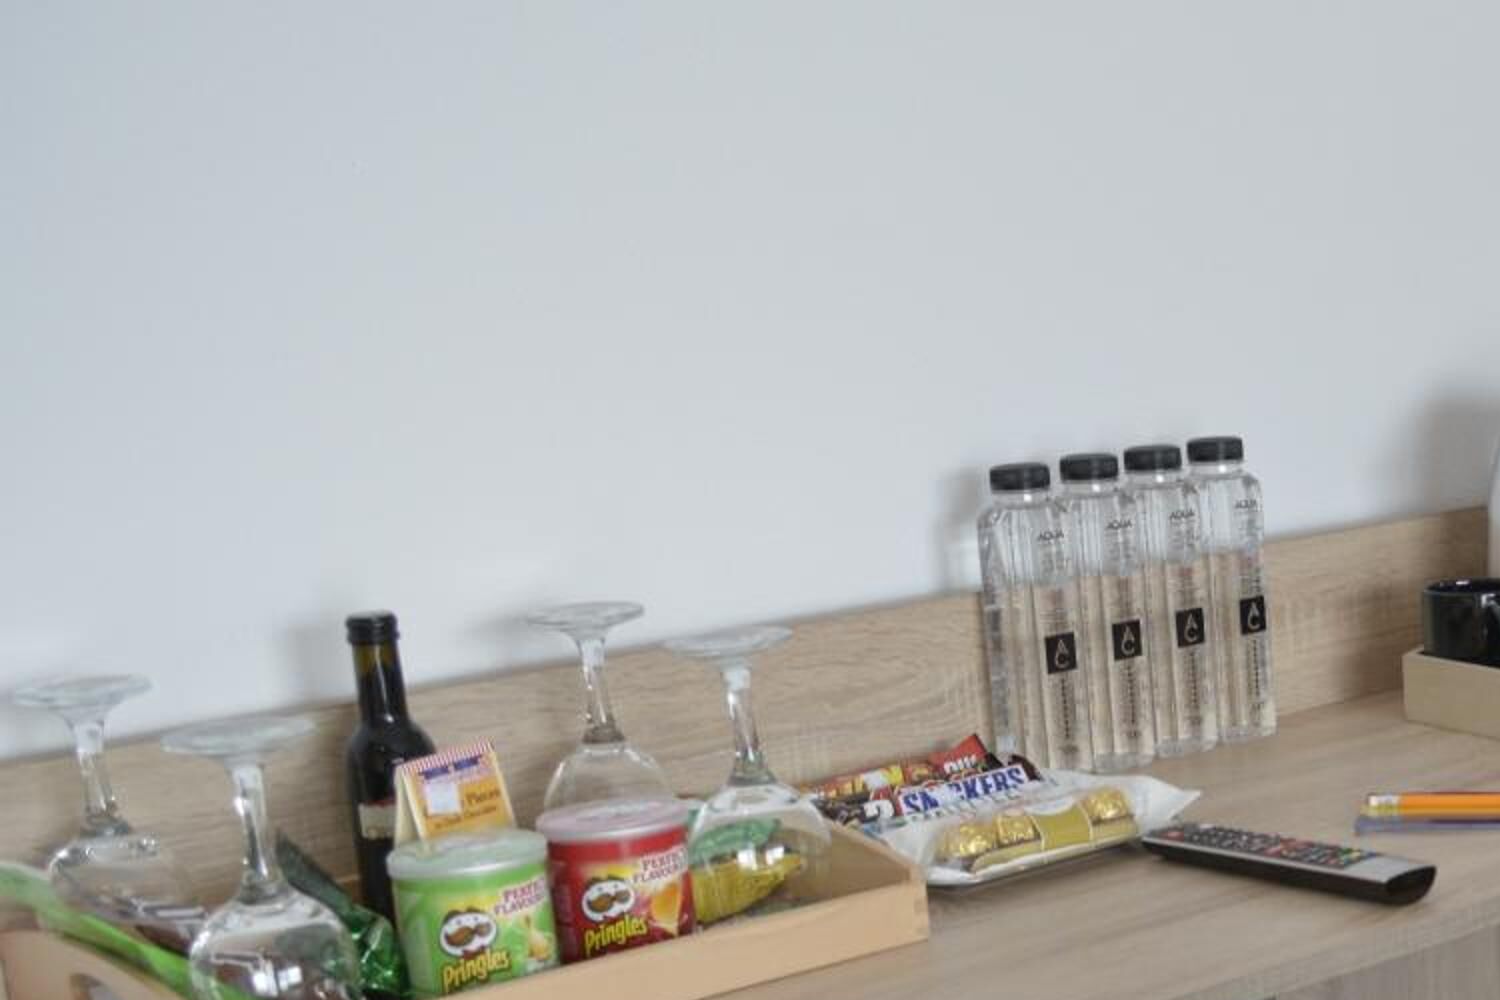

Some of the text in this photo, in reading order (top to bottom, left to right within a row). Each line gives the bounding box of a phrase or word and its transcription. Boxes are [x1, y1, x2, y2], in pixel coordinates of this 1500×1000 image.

[902, 766, 1026, 816] SNCKERS
[584, 914, 648, 958] Pringles
[442, 949, 510, 993] Pringles
